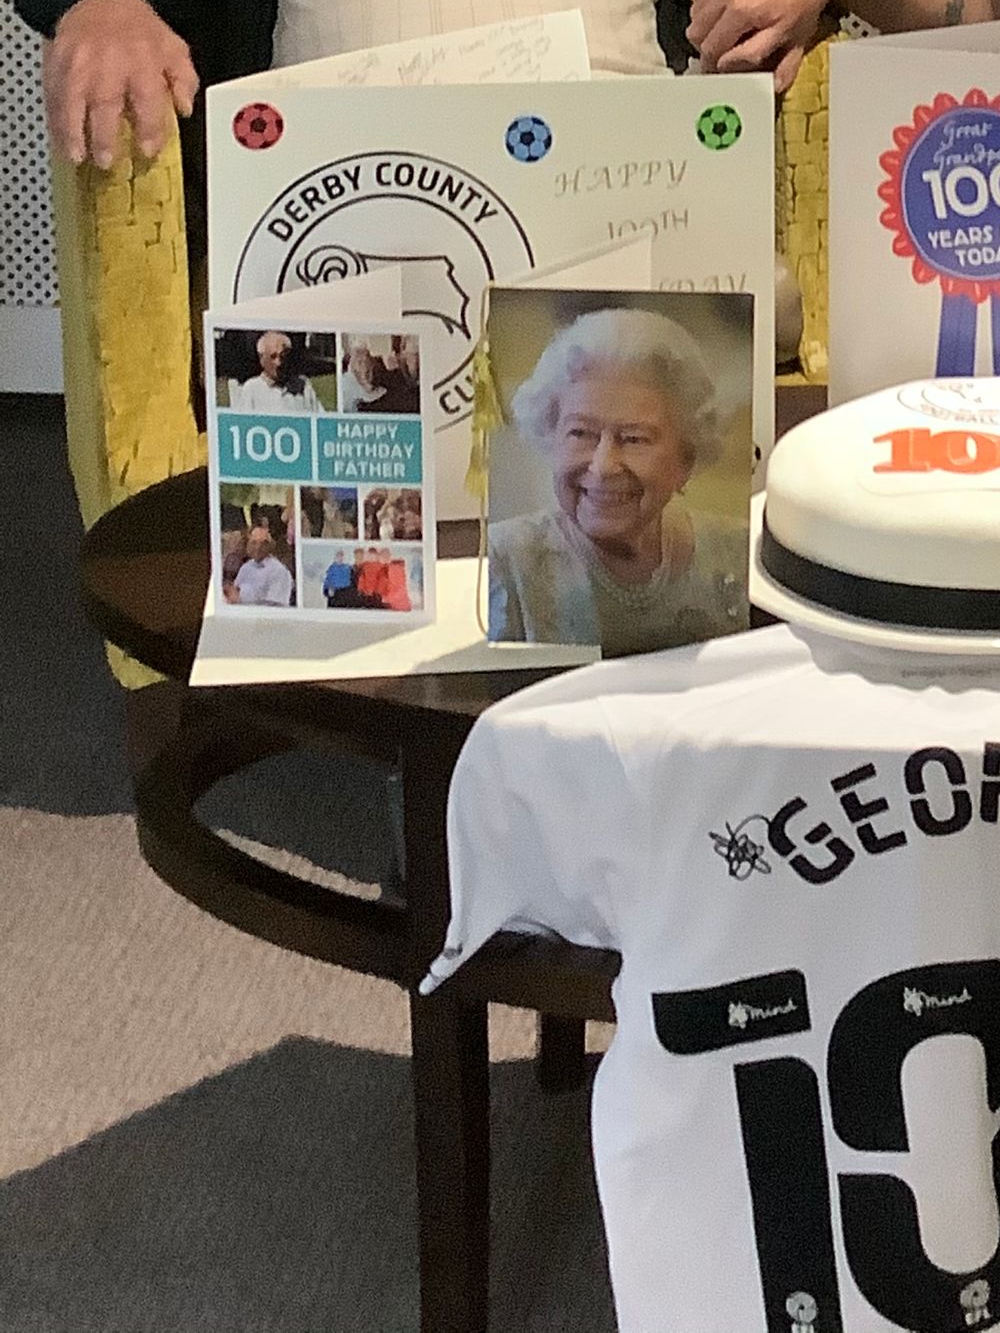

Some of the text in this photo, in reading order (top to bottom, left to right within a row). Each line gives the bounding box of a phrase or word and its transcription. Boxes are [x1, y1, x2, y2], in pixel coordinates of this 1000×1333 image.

[554, 158, 688, 198] HAPPY
[267, 162, 498, 242] DERBY COUNTY
[928, 225, 993, 248] YEARS
[336, 423, 398, 439] HAPPY
[229, 424, 300, 463] 100
[323, 441, 414, 459] BIRTHDAY
[334, 460, 406, 477] FATHER
